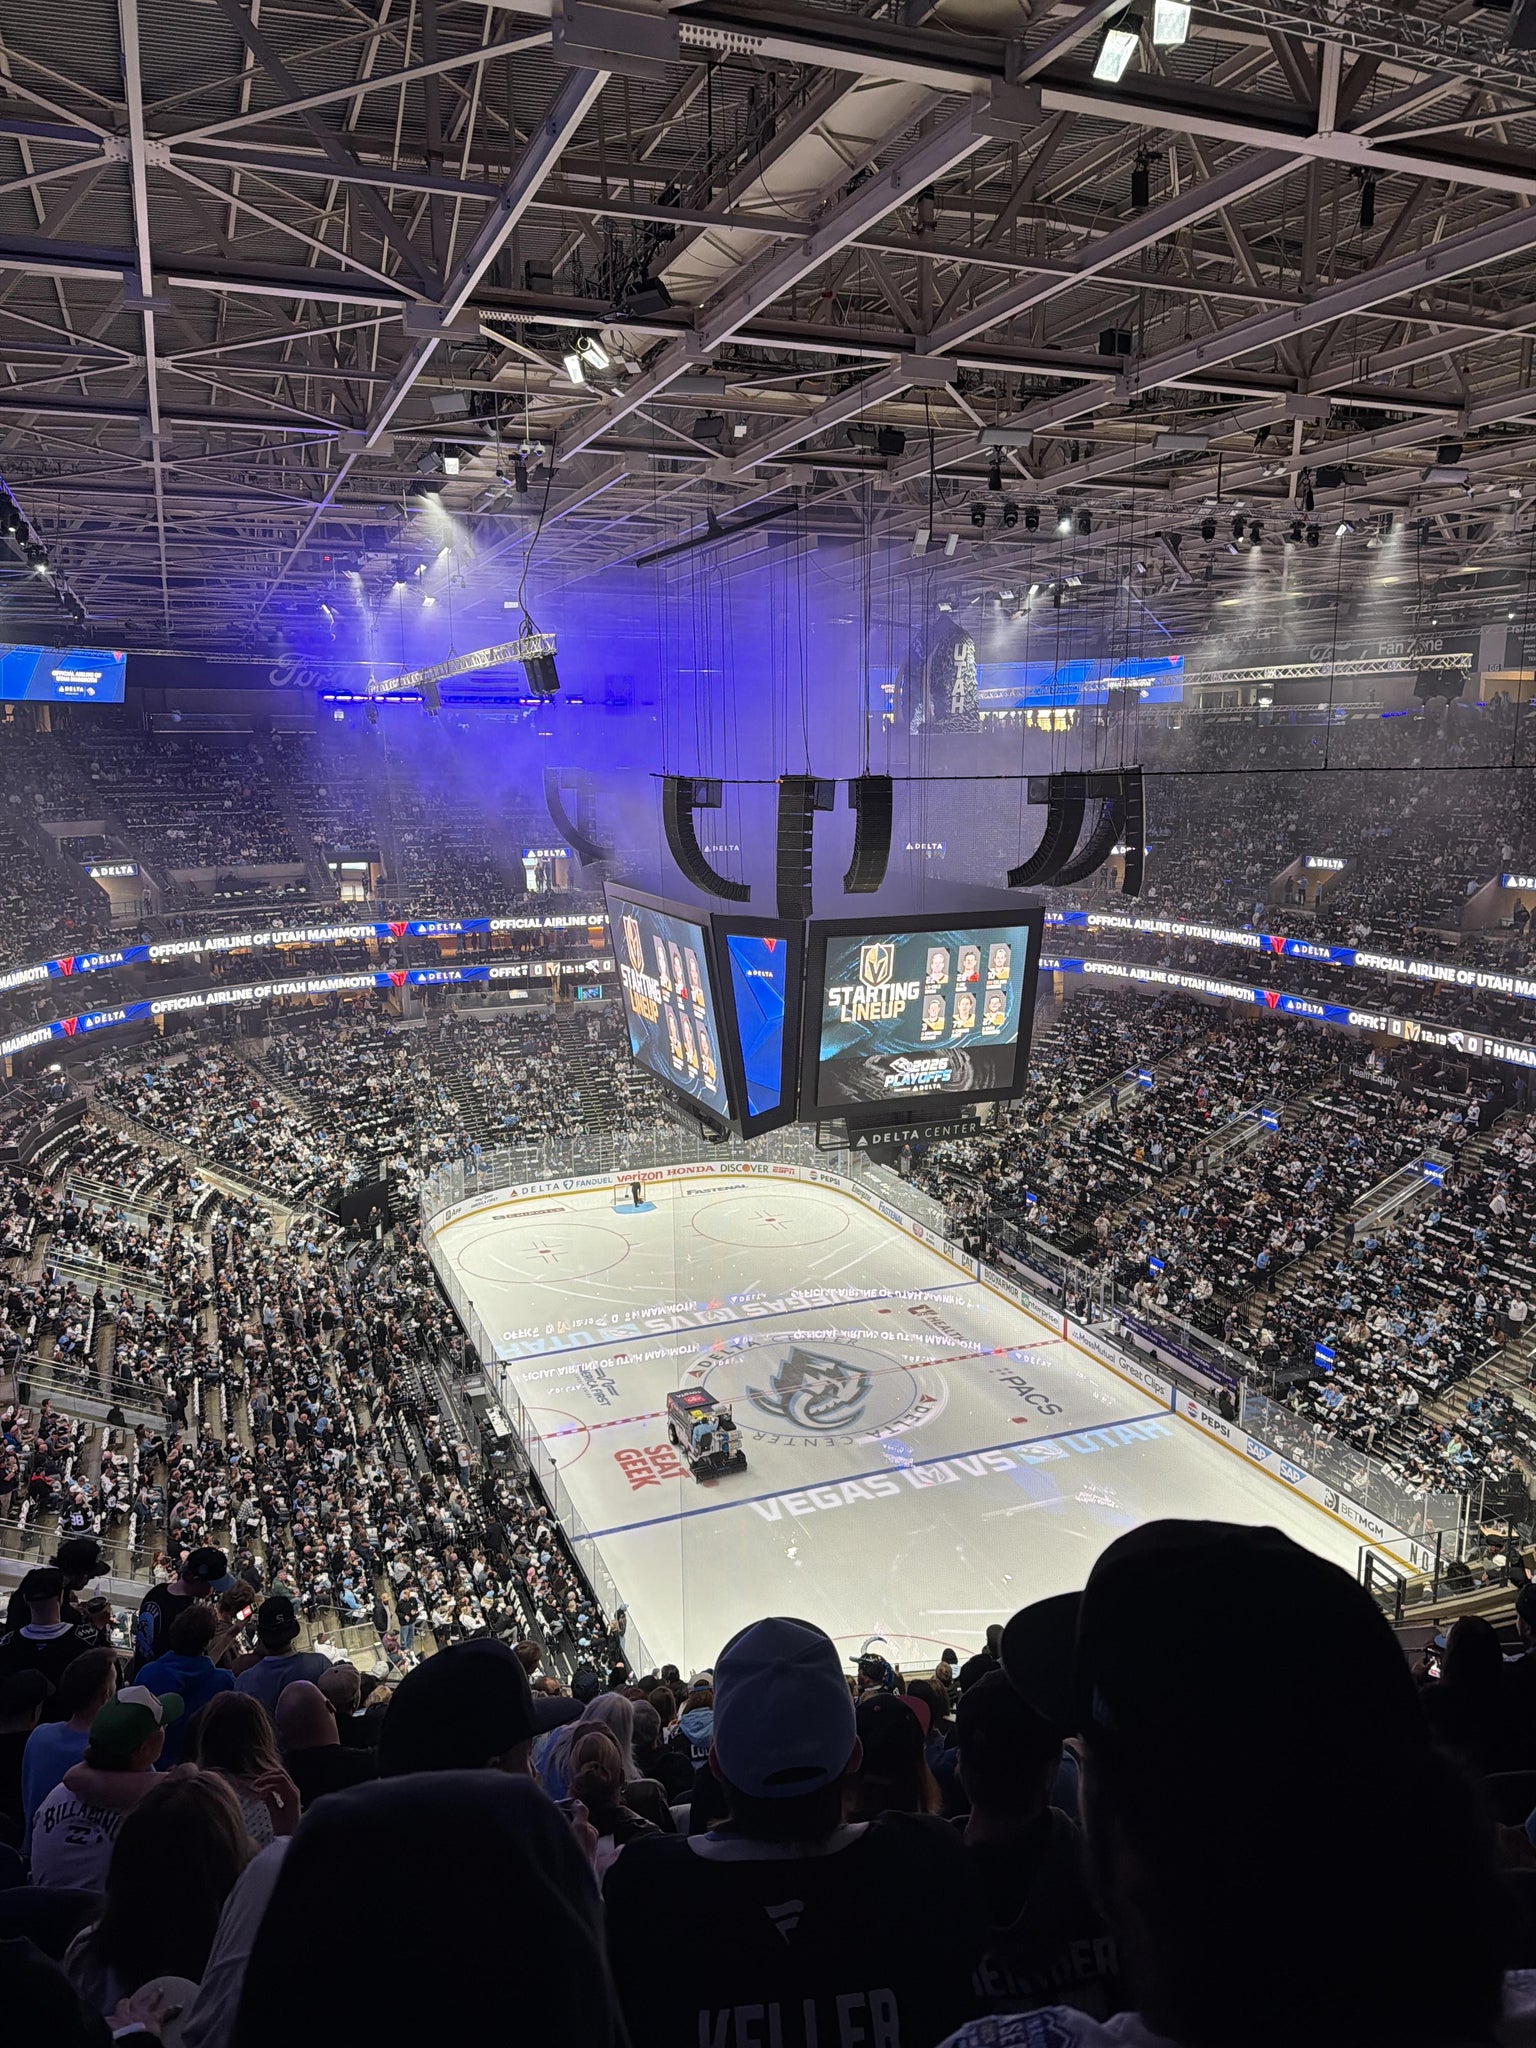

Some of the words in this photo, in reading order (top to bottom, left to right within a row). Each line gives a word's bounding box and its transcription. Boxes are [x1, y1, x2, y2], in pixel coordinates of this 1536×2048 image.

[1378, 640, 1403, 655] Fan
[1406, 638, 1443, 654] Zne
[952, 643, 967, 714] UTAH
[537, 849, 567, 857] DELTA
[712, 844, 740, 852] DELTA
[914, 842, 943, 850] DELTA
[100, 866, 134, 876] DELTA
[1317, 859, 1343, 869] DELTA
[428, 923, 462, 931] DELTA
[490, 918, 542, 930] OFFICIAL
[543, 916, 586, 927] AIRLINE
[587, 915, 604, 925] OF
[1088, 914, 1132, 929] OFFICIAL
[1134, 919, 1171, 933] AIRLINE
[1171, 923, 1185, 935] OF
[1185, 924, 1210, 939] UTAH
[1211, 929, 1261, 948] MAMMOTH
[149, 940, 203, 957] OFFICIAL
[204, 935, 252, 950] AIRLINE
[253, 932, 271, 945] OF
[272, 929, 306, 943] UTAH
[307, 926, 376, 941] MAMMOTH
[91, 953, 123, 966] DELTA
[1301, 946, 1330, 957] DELTA
[561, 964, 585, 974] 12:19
[603, 961, 611, 971] 0
[753, 970, 774, 978] DELTA
[1355, 952, 1407, 973] OFFICIAL
[1407, 961, 1456, 982] AIRLINE
[1456, 969, 1476, 985] OF
[1476, 973, 1513, 992] UTAH
[428, 971, 461, 980] DELTA
[620, 963, 662, 1005] STARTING
[1083, 962, 1128, 977] OFFICIAL
[1129, 967, 1167, 983] AIRLINE
[1167, 972, 1180, 985] OF
[1180, 974, 1206, 990] UTAH
[1206, 979, 1255, 1001] MAMMOTH
[151, 995, 205, 1014] OFFICIAL
[206, 987, 253, 1005] AIRLINE
[254, 983, 272, 997] OF
[272, 980, 306, 995] UTAH
[308, 976, 376, 991] MAMMOTH
[828, 981, 920, 1007] STARTING
[629, 988, 660, 1025] LINEUP
[840, 1000, 906, 1023] LINEUP
[1296, 1002, 1324, 1015] DELTA
[95, 1010, 126, 1024] DELTA
[1392, 1020, 1401, 1035] 0
[2, 1027, 52, 1054] MAMMOTH
[1421, 1030, 1447, 1046] 12:19
[1467, 1037, 1478, 1052] 0
[912, 1058, 949, 1072] 2026
[884, 1069, 953, 1087] PLAYOFFS
[1349, 1066, 1398, 1089] HealthEquity
[919, 1083, 941, 1091] DELTA
[872, 1129, 920, 1145] DELTA
[924, 1123, 977, 1138] CENTER
[617, 1171, 664, 1183] verizon
[666, 1164, 715, 1176] HONDA
[719, 1163, 769, 1174] DISCOVER
[772, 1165, 795, 1175] ESPN
[576, 1176, 613, 1188] FANDUEL
[820, 1173, 841, 1186] PEPSI
[521, 1182, 560, 1195] DELTA
[878, 1201, 903, 1226] FASTENAL
[943, 1241, 955, 1260] CAT
[961, 1253, 974, 1273] CAT
[984, 1268, 1019, 1299] BODYARMOR
[1078, 1333, 1116, 1363] MassMutual
[1118, 1357, 1143, 1381] Great
[1144, 1374, 1165, 1395] Clips
[593, 1386, 612, 1407] FIRST
[998, 1375, 1064, 1416] PACS
[865, 1405, 930, 1439] DELTA
[1201, 1411, 1230, 1439] PEPSI
[752, 1431, 855, 1447] CENTER
[1247, 1442, 1268, 1460] SAP
[613, 1448, 661, 1492] GEEK
[643, 1443, 691, 1480] SEAT
[747, 1474, 901, 1522] VEGAS
[950, 1450, 1018, 1477] VS
[1059, 1419, 1174, 1455] UTAH
[1280, 1466, 1301, 1483] SAP
[1341, 1503, 1384, 1539] BETMGM
